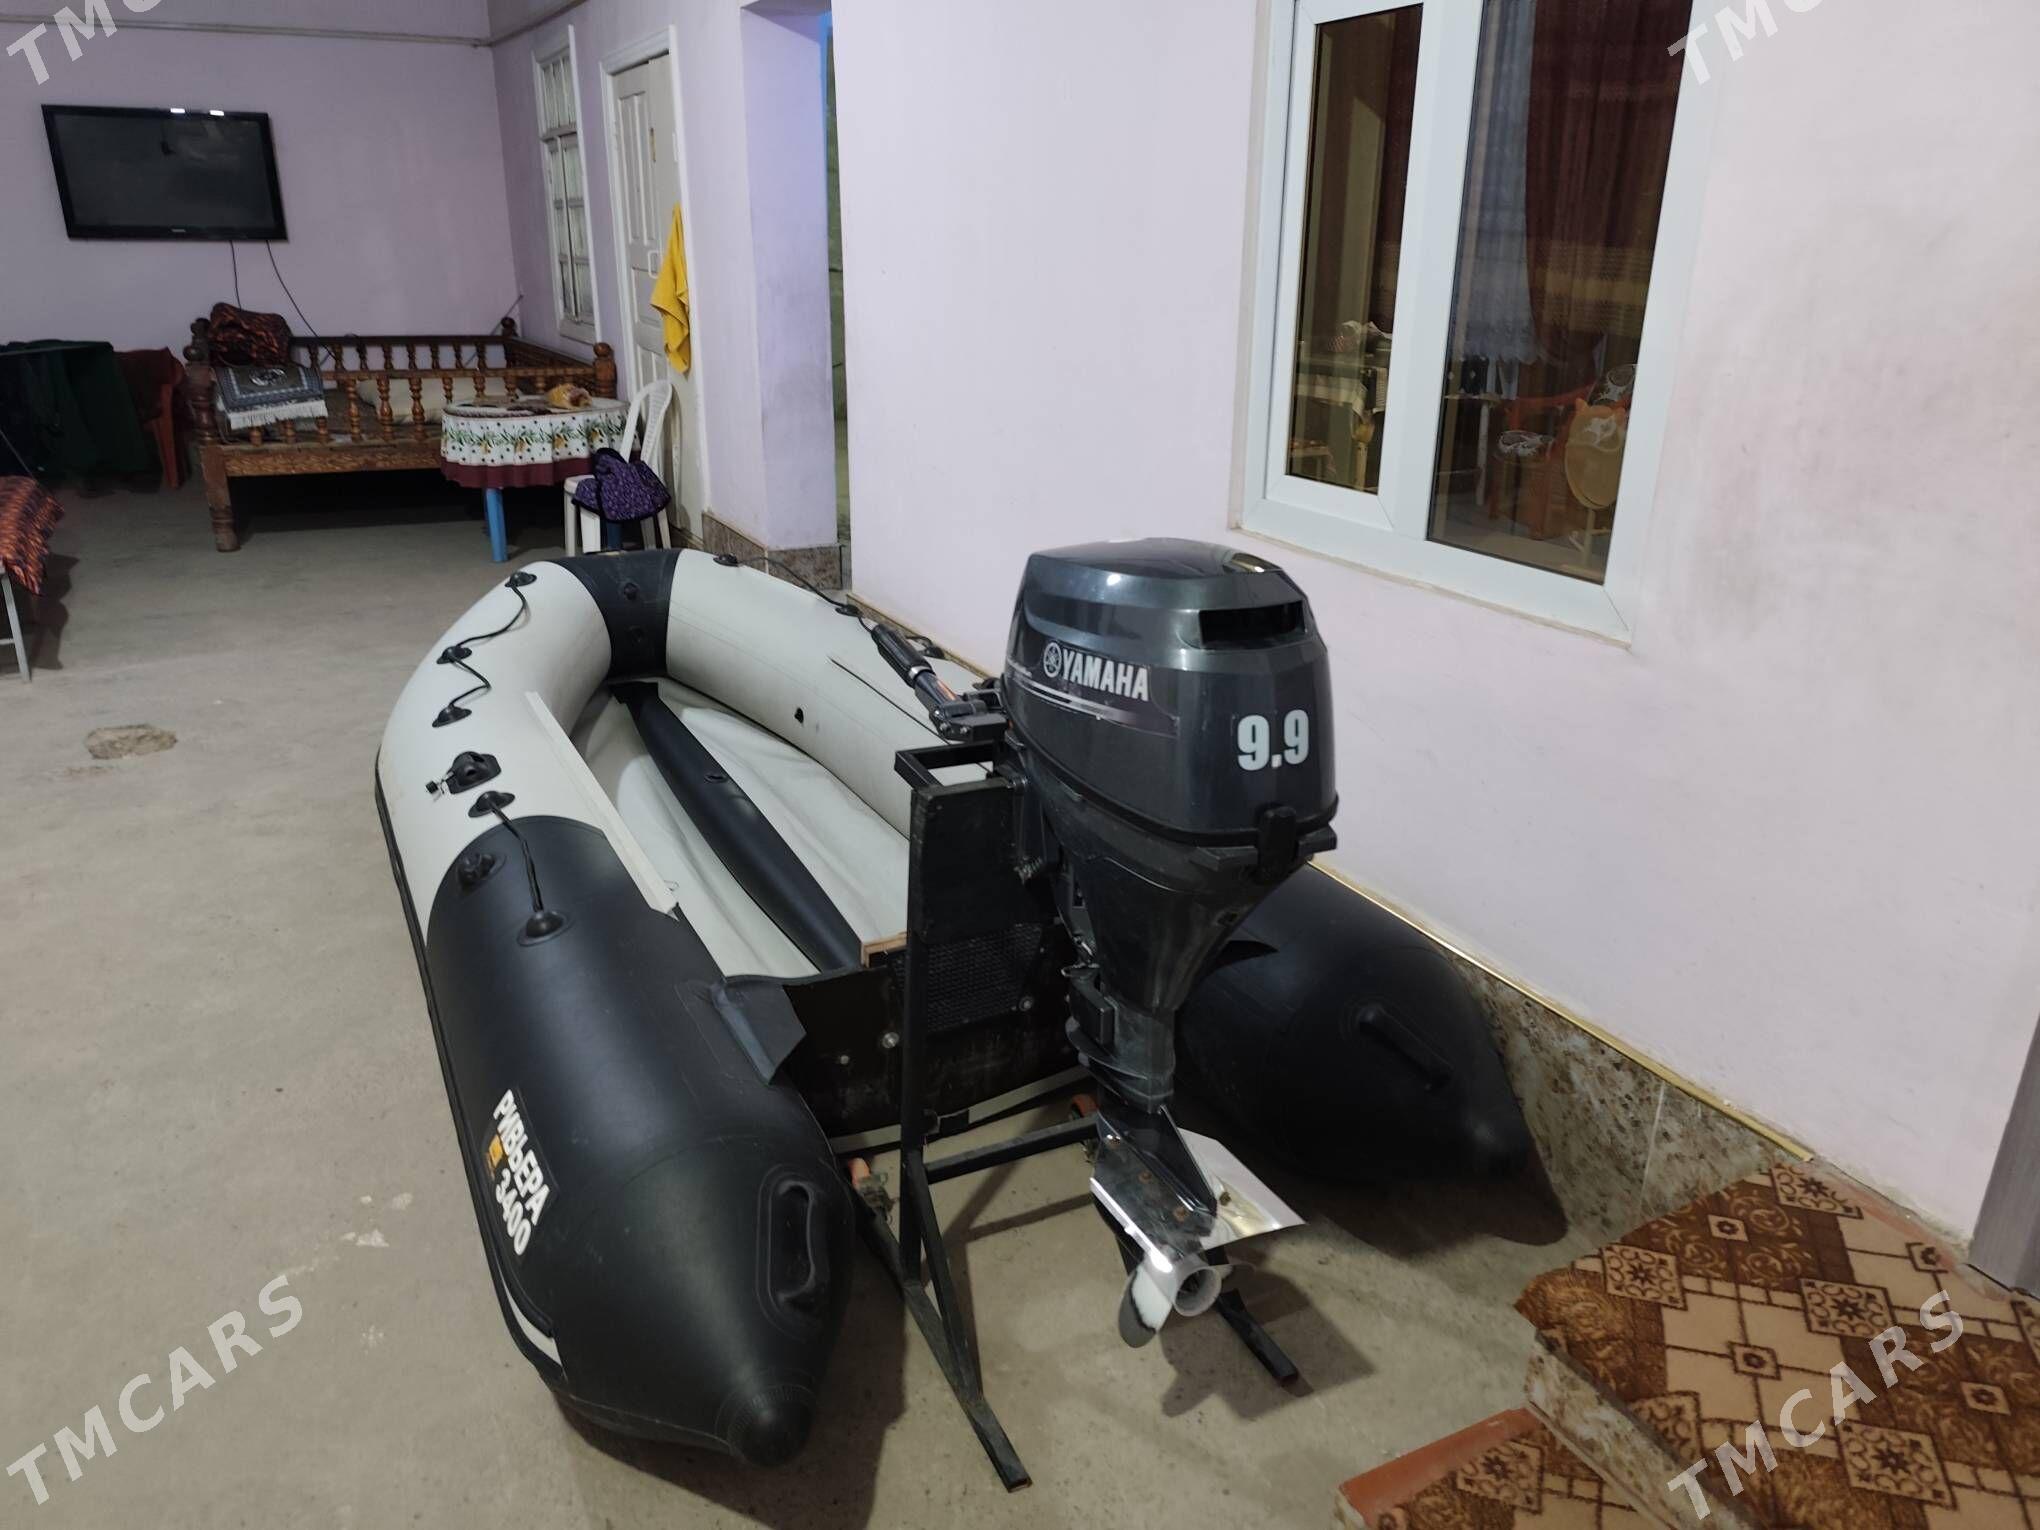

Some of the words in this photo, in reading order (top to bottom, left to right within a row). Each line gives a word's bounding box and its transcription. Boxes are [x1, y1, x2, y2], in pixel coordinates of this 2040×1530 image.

[1062, 648, 1149, 702] YAMAHA
[1237, 709, 1309, 771] 9.9
[493, 1089, 550, 1226] РИВЬЕРА
[496, 1168, 532, 1256] 3400
